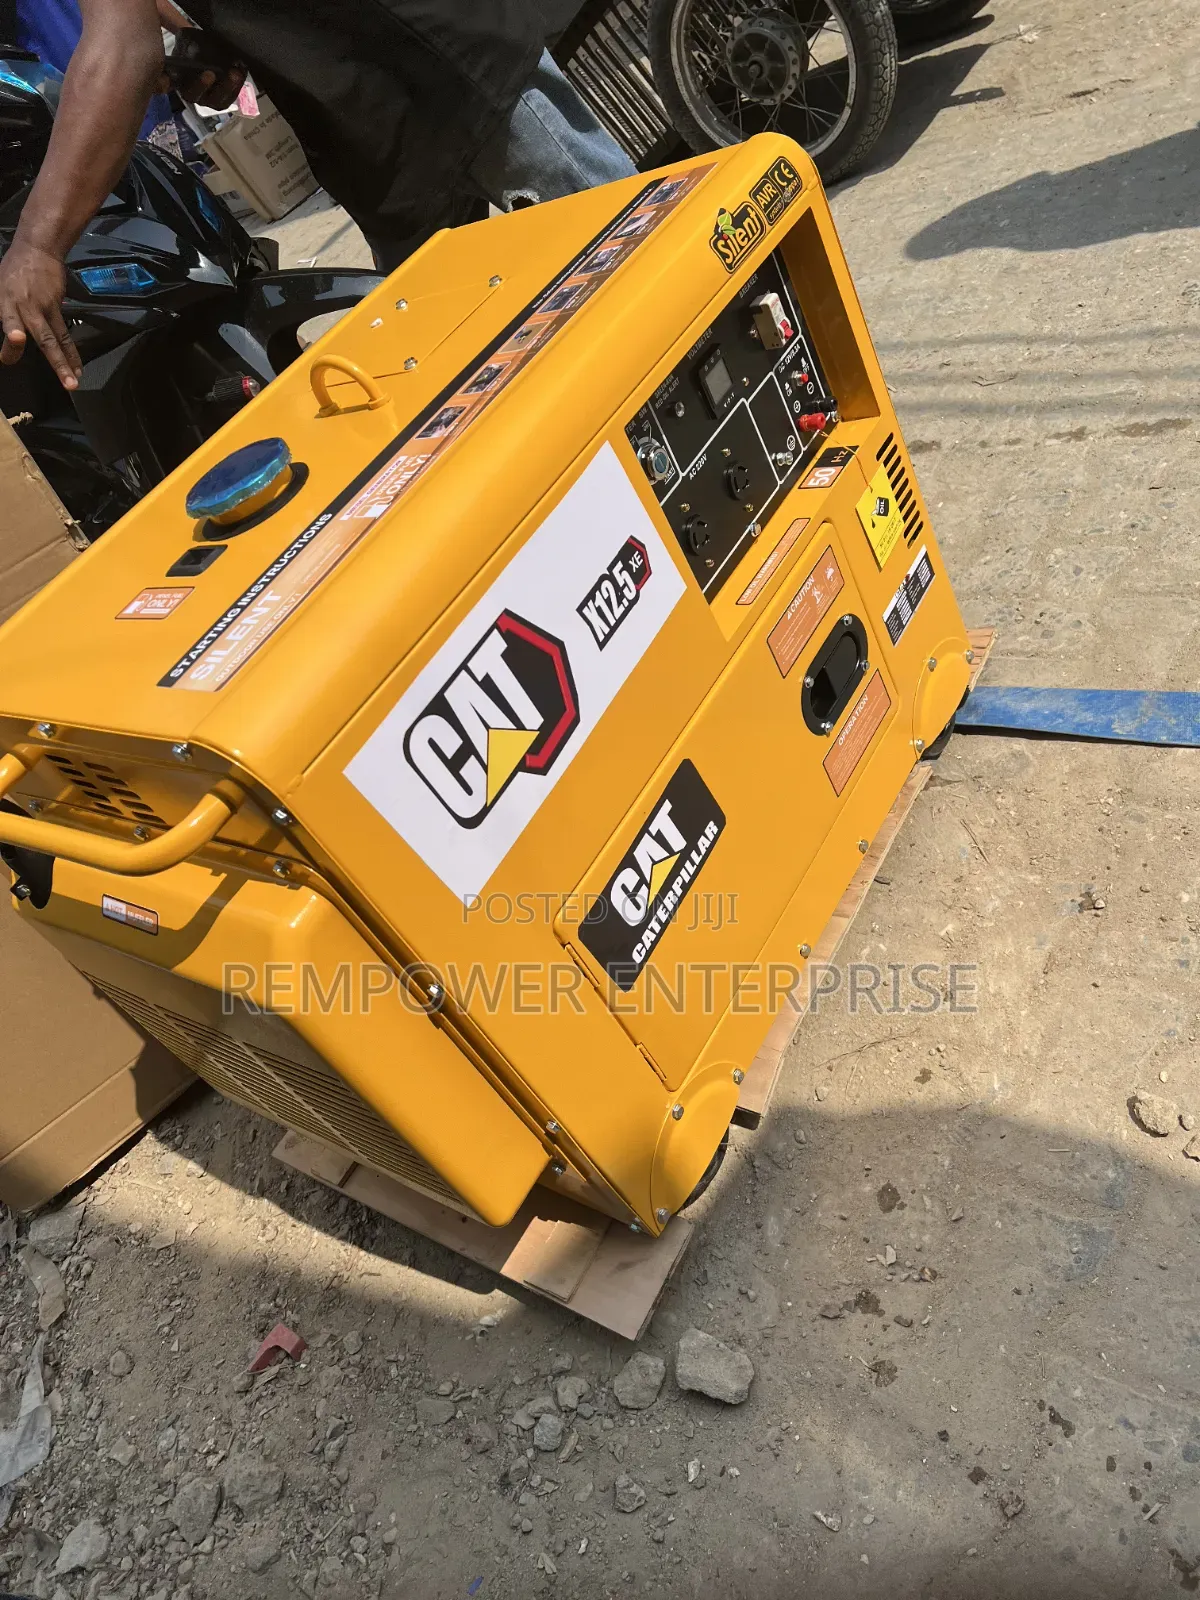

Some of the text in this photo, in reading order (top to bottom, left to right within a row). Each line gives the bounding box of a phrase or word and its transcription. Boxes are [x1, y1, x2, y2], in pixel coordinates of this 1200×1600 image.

[756, 183, 777, 208] AVR
[717, 206, 761, 264] Silent
[739, 273, 758, 298] BREAKER
[686, 328, 713, 360] VOLTMETER
[386, 454, 432, 496] ONLY!
[689, 453, 708, 480] AC 220V
[807, 450, 848, 486] 50 Hz
[170, 607, 241, 678] STARTING
[237, 512, 333, 606] INSTRUCTIONS
[582, 549, 644, 643] X12.5 XE
[789, 575, 815, 613] CAUTION
[190, 590, 282, 681] SILENT
[215, 637, 257, 683] OUTDOOR
[409, 628, 545, 819] CAT
[838, 694, 869, 746] OPERATION
[611, 799, 687, 926] CAT
[632, 820, 719, 964] CATERPILLAR
